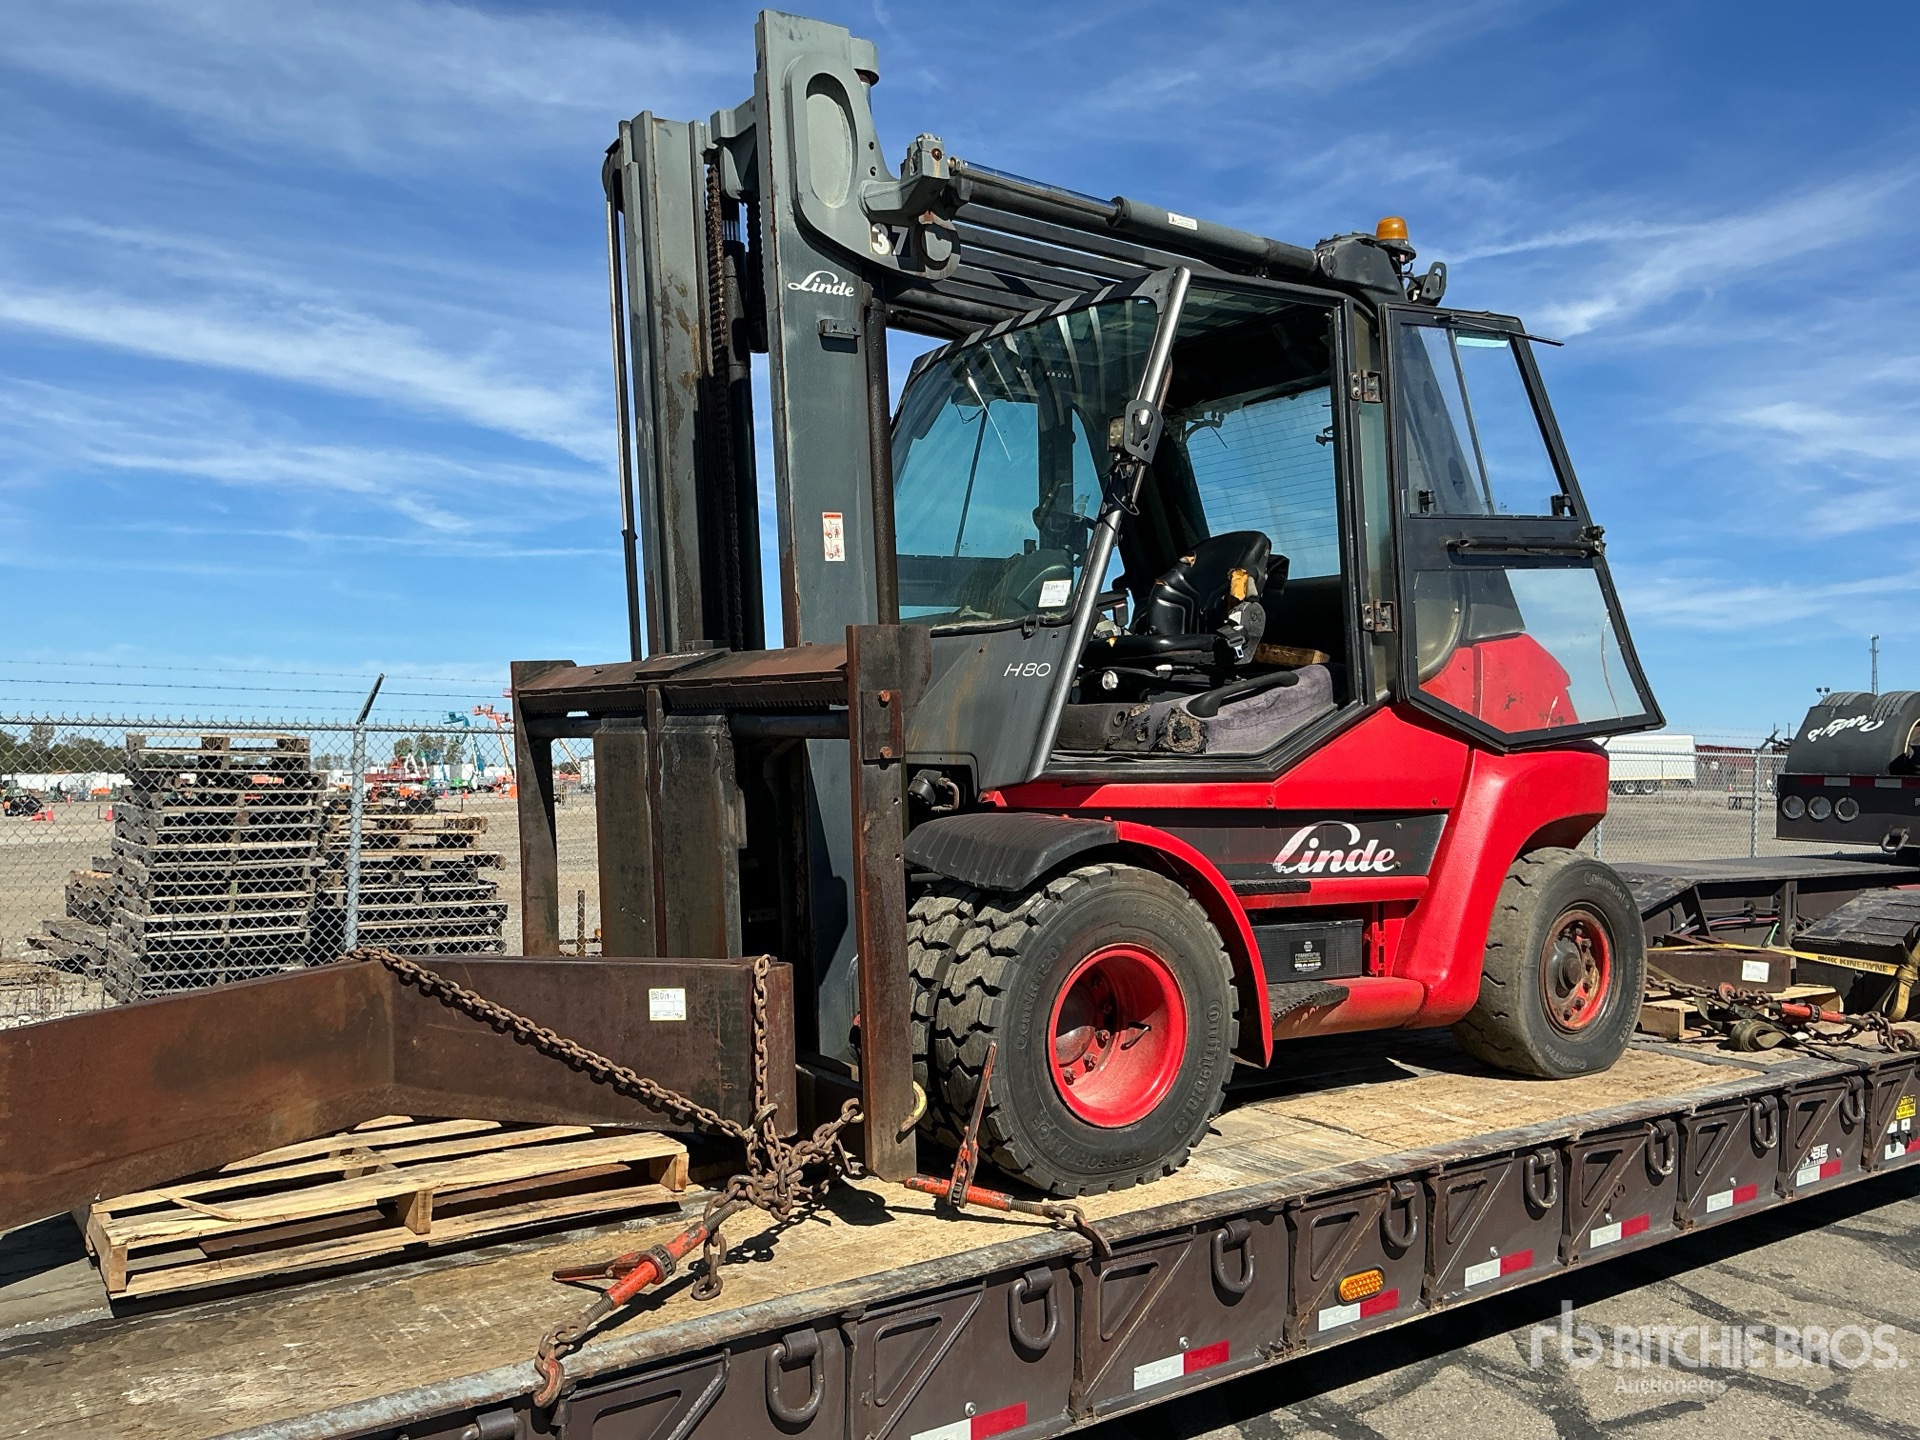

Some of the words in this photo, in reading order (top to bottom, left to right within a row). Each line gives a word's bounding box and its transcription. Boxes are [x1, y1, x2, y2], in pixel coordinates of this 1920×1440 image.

[872, 222, 909, 256] 37
[787, 270, 855, 297] Linde
[1003, 662, 1052, 677] H80
[1272, 820, 1395, 874] Linde
[1839, 958, 1889, 973] KINEDYNE
